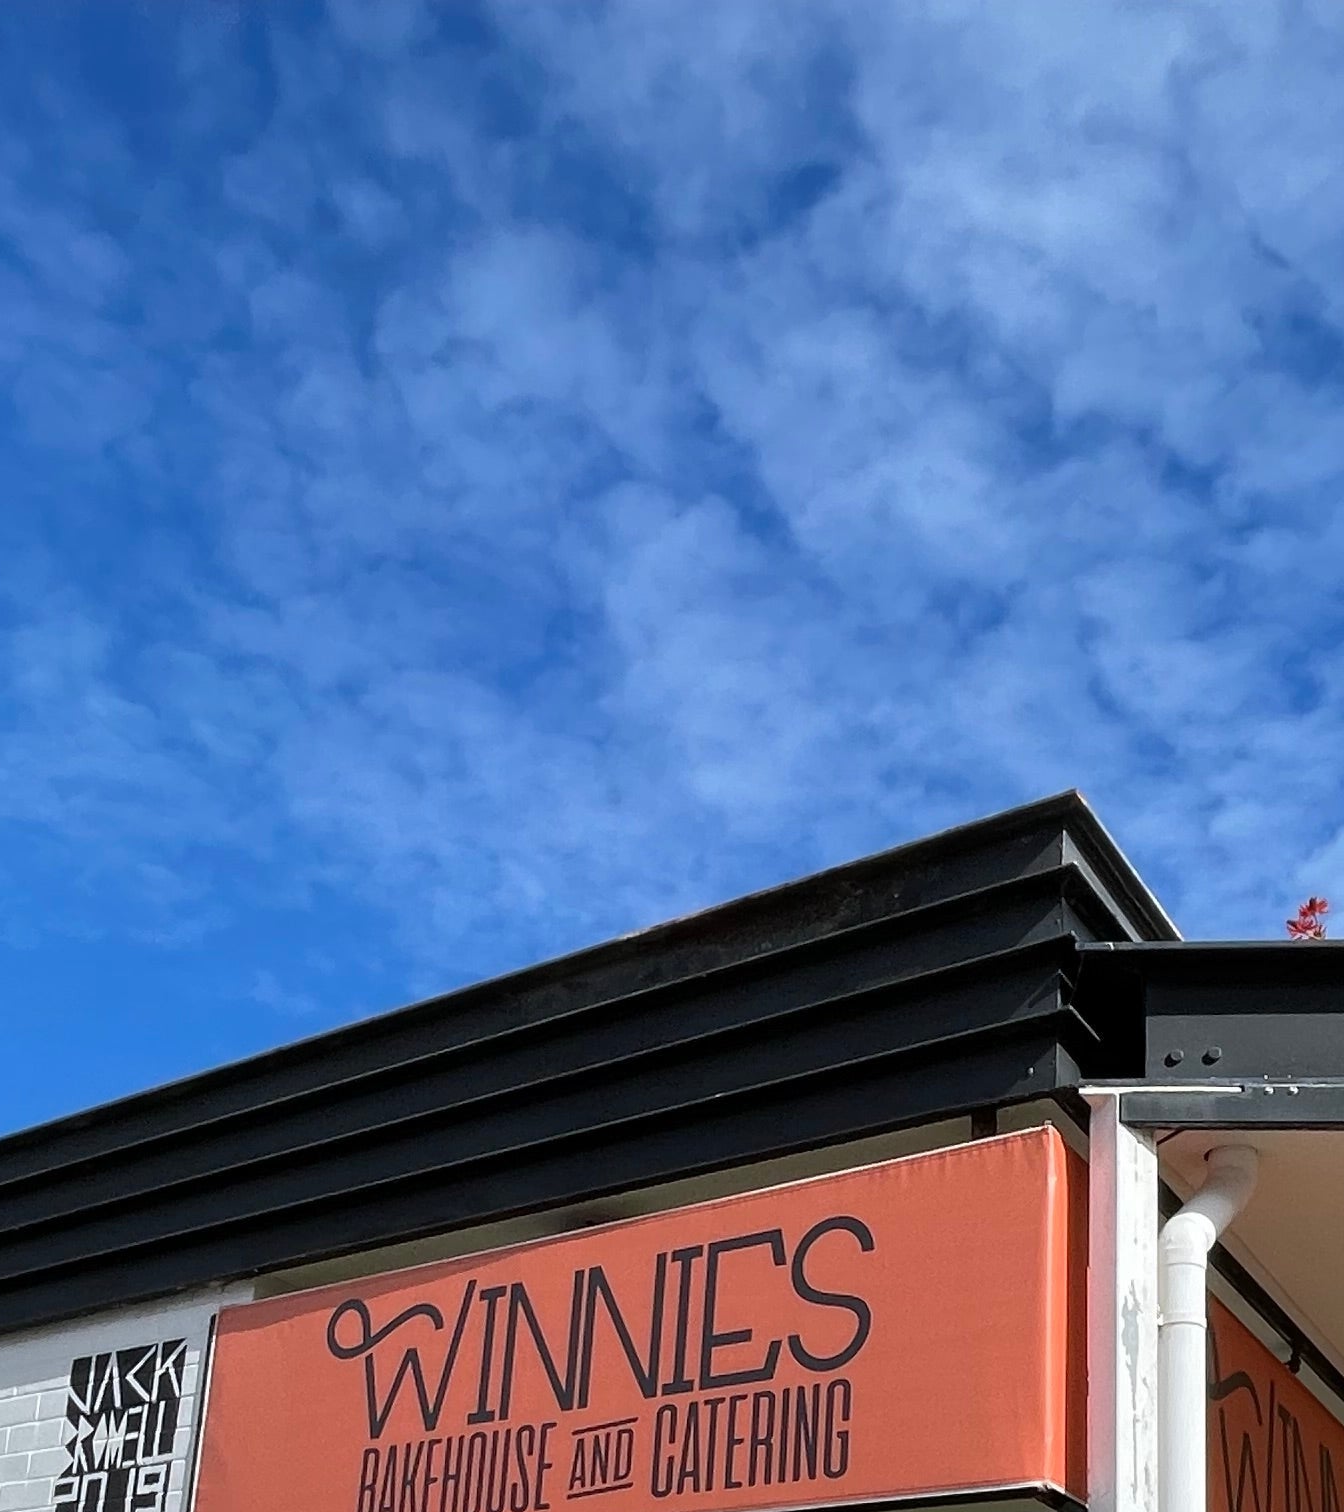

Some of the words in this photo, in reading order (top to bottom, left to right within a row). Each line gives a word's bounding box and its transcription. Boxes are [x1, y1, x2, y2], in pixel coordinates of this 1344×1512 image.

[68, 1338, 188, 1415] JACK
[327, 1215, 876, 1441] WINNIES
[568, 1420, 638, 1496] AND
[651, 1379, 852, 1498] CATERING
